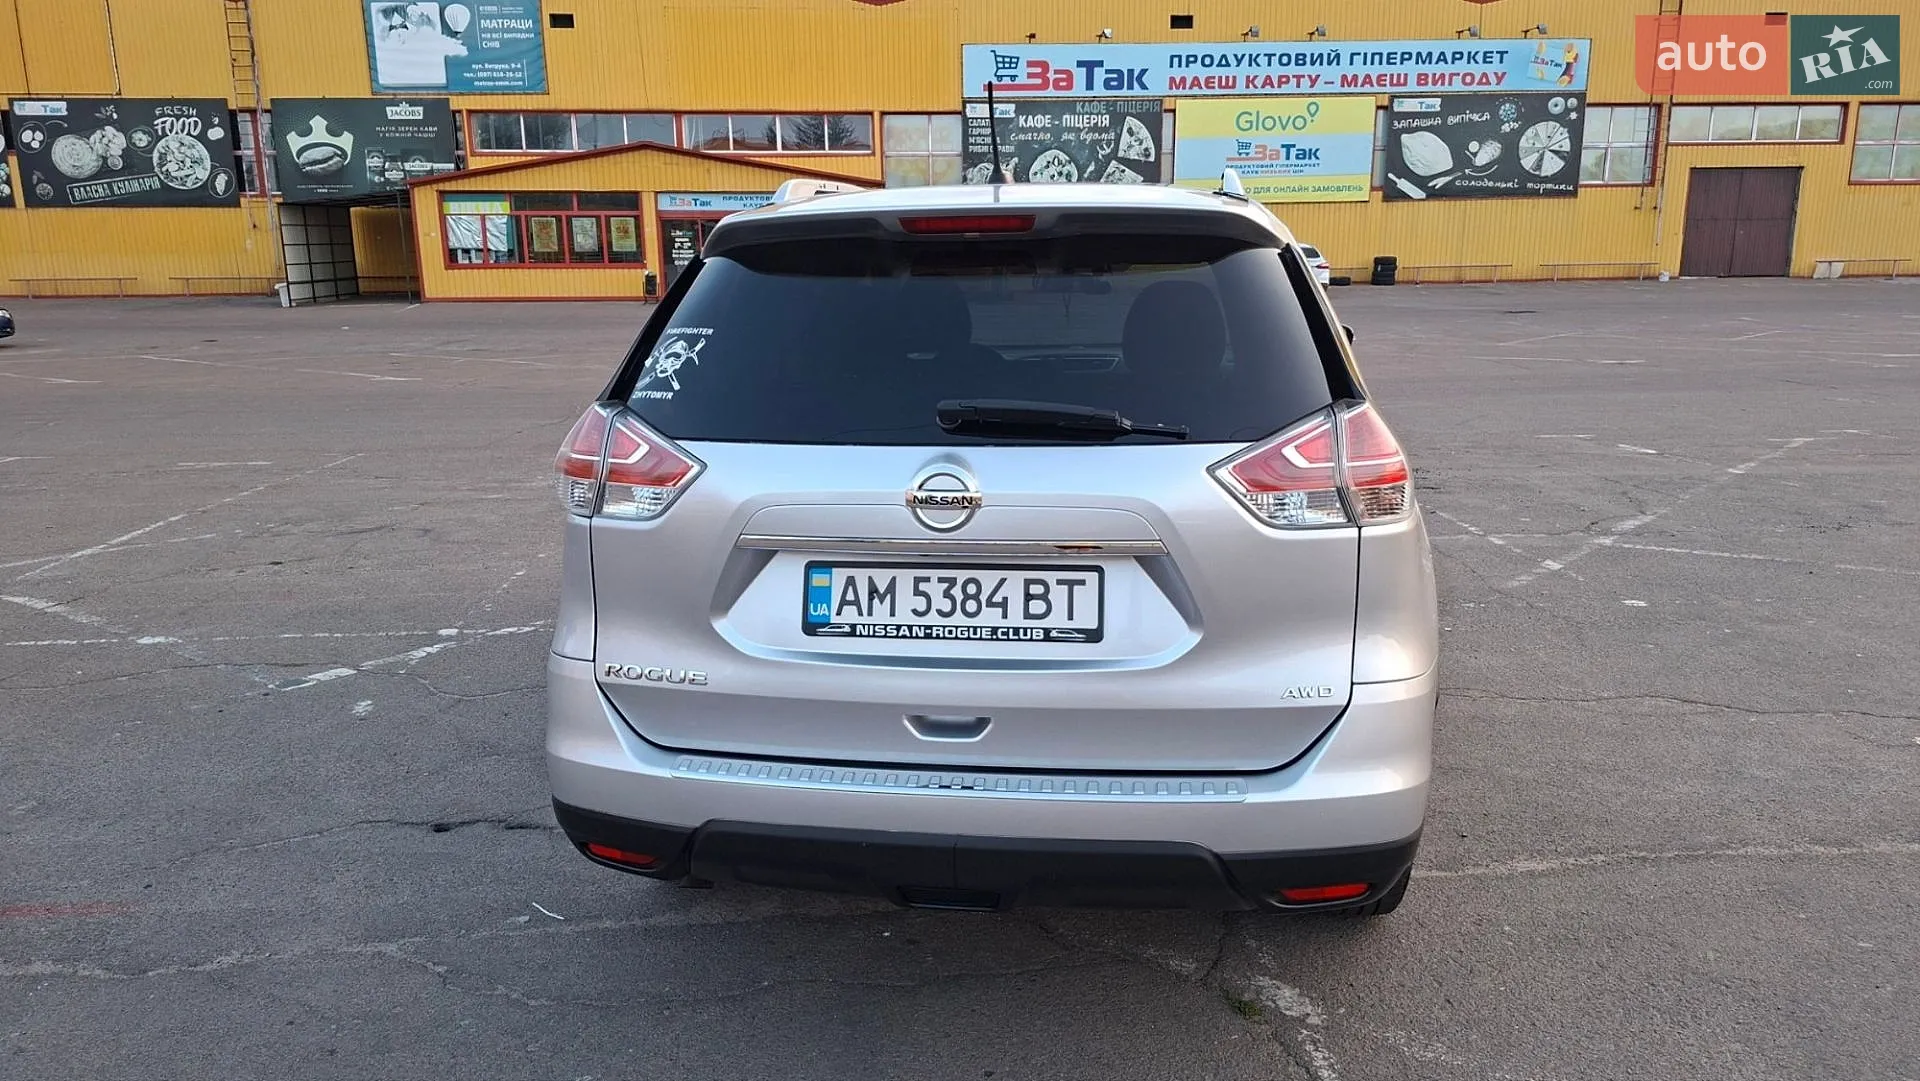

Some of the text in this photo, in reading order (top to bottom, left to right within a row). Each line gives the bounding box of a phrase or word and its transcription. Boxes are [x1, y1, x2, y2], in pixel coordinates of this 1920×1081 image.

[481, 19, 533, 29] МАТРАЦИ
[1168, 48, 1341, 69] ПРОДУКТОВИЙ
[1349, 50, 1509, 67] ГІПЕРМАРКЕТ
[1168, 74, 1238, 90] МАЄШ
[1244, 73, 1320, 90] КАРТУ
[1340, 72, 1409, 89] МАЄШ
[1416, 71, 1507, 88] ВИГОДУ
[154, 105, 197, 117] FRESH
[389, 108, 422, 118] JACOBS
[1076, 101, 1107, 114] КАФЕ
[1116, 100, 1161, 114] ПІЦЕРІЯ
[153, 116, 202, 136] FOOD
[1018, 114, 1052, 128] КАФЕ
[1062, 114, 1111, 130] ПІЦЕРІЯ
[1235, 110, 1307, 132] Glovo
[1391, 109, 1490, 130] ЗАПАШНА ВИПІЧКА
[72, 175, 161, 202] ВЛАСНА КУЛІНАРІЯ
[1253, 186, 1271, 195] ДЛЯ
[1273, 184, 1310, 194] ОНЛАЙН
[1311, 184, 1364, 193] ЗАМОВЛЕНЬ
[666, 327, 714, 336] FIREFIGHTER
[632, 390, 674, 400] ZHYTOMYR
[912, 494, 974, 507] NISSAN
[835, 575, 1087, 622] AM 5384 BT
[810, 602, 829, 617] UA
[855, 623, 1044, 640] NISSAN-ROGUE.CLUB
[604, 662, 709, 686] ROGUE
[1279, 685, 1336, 700] AWD
